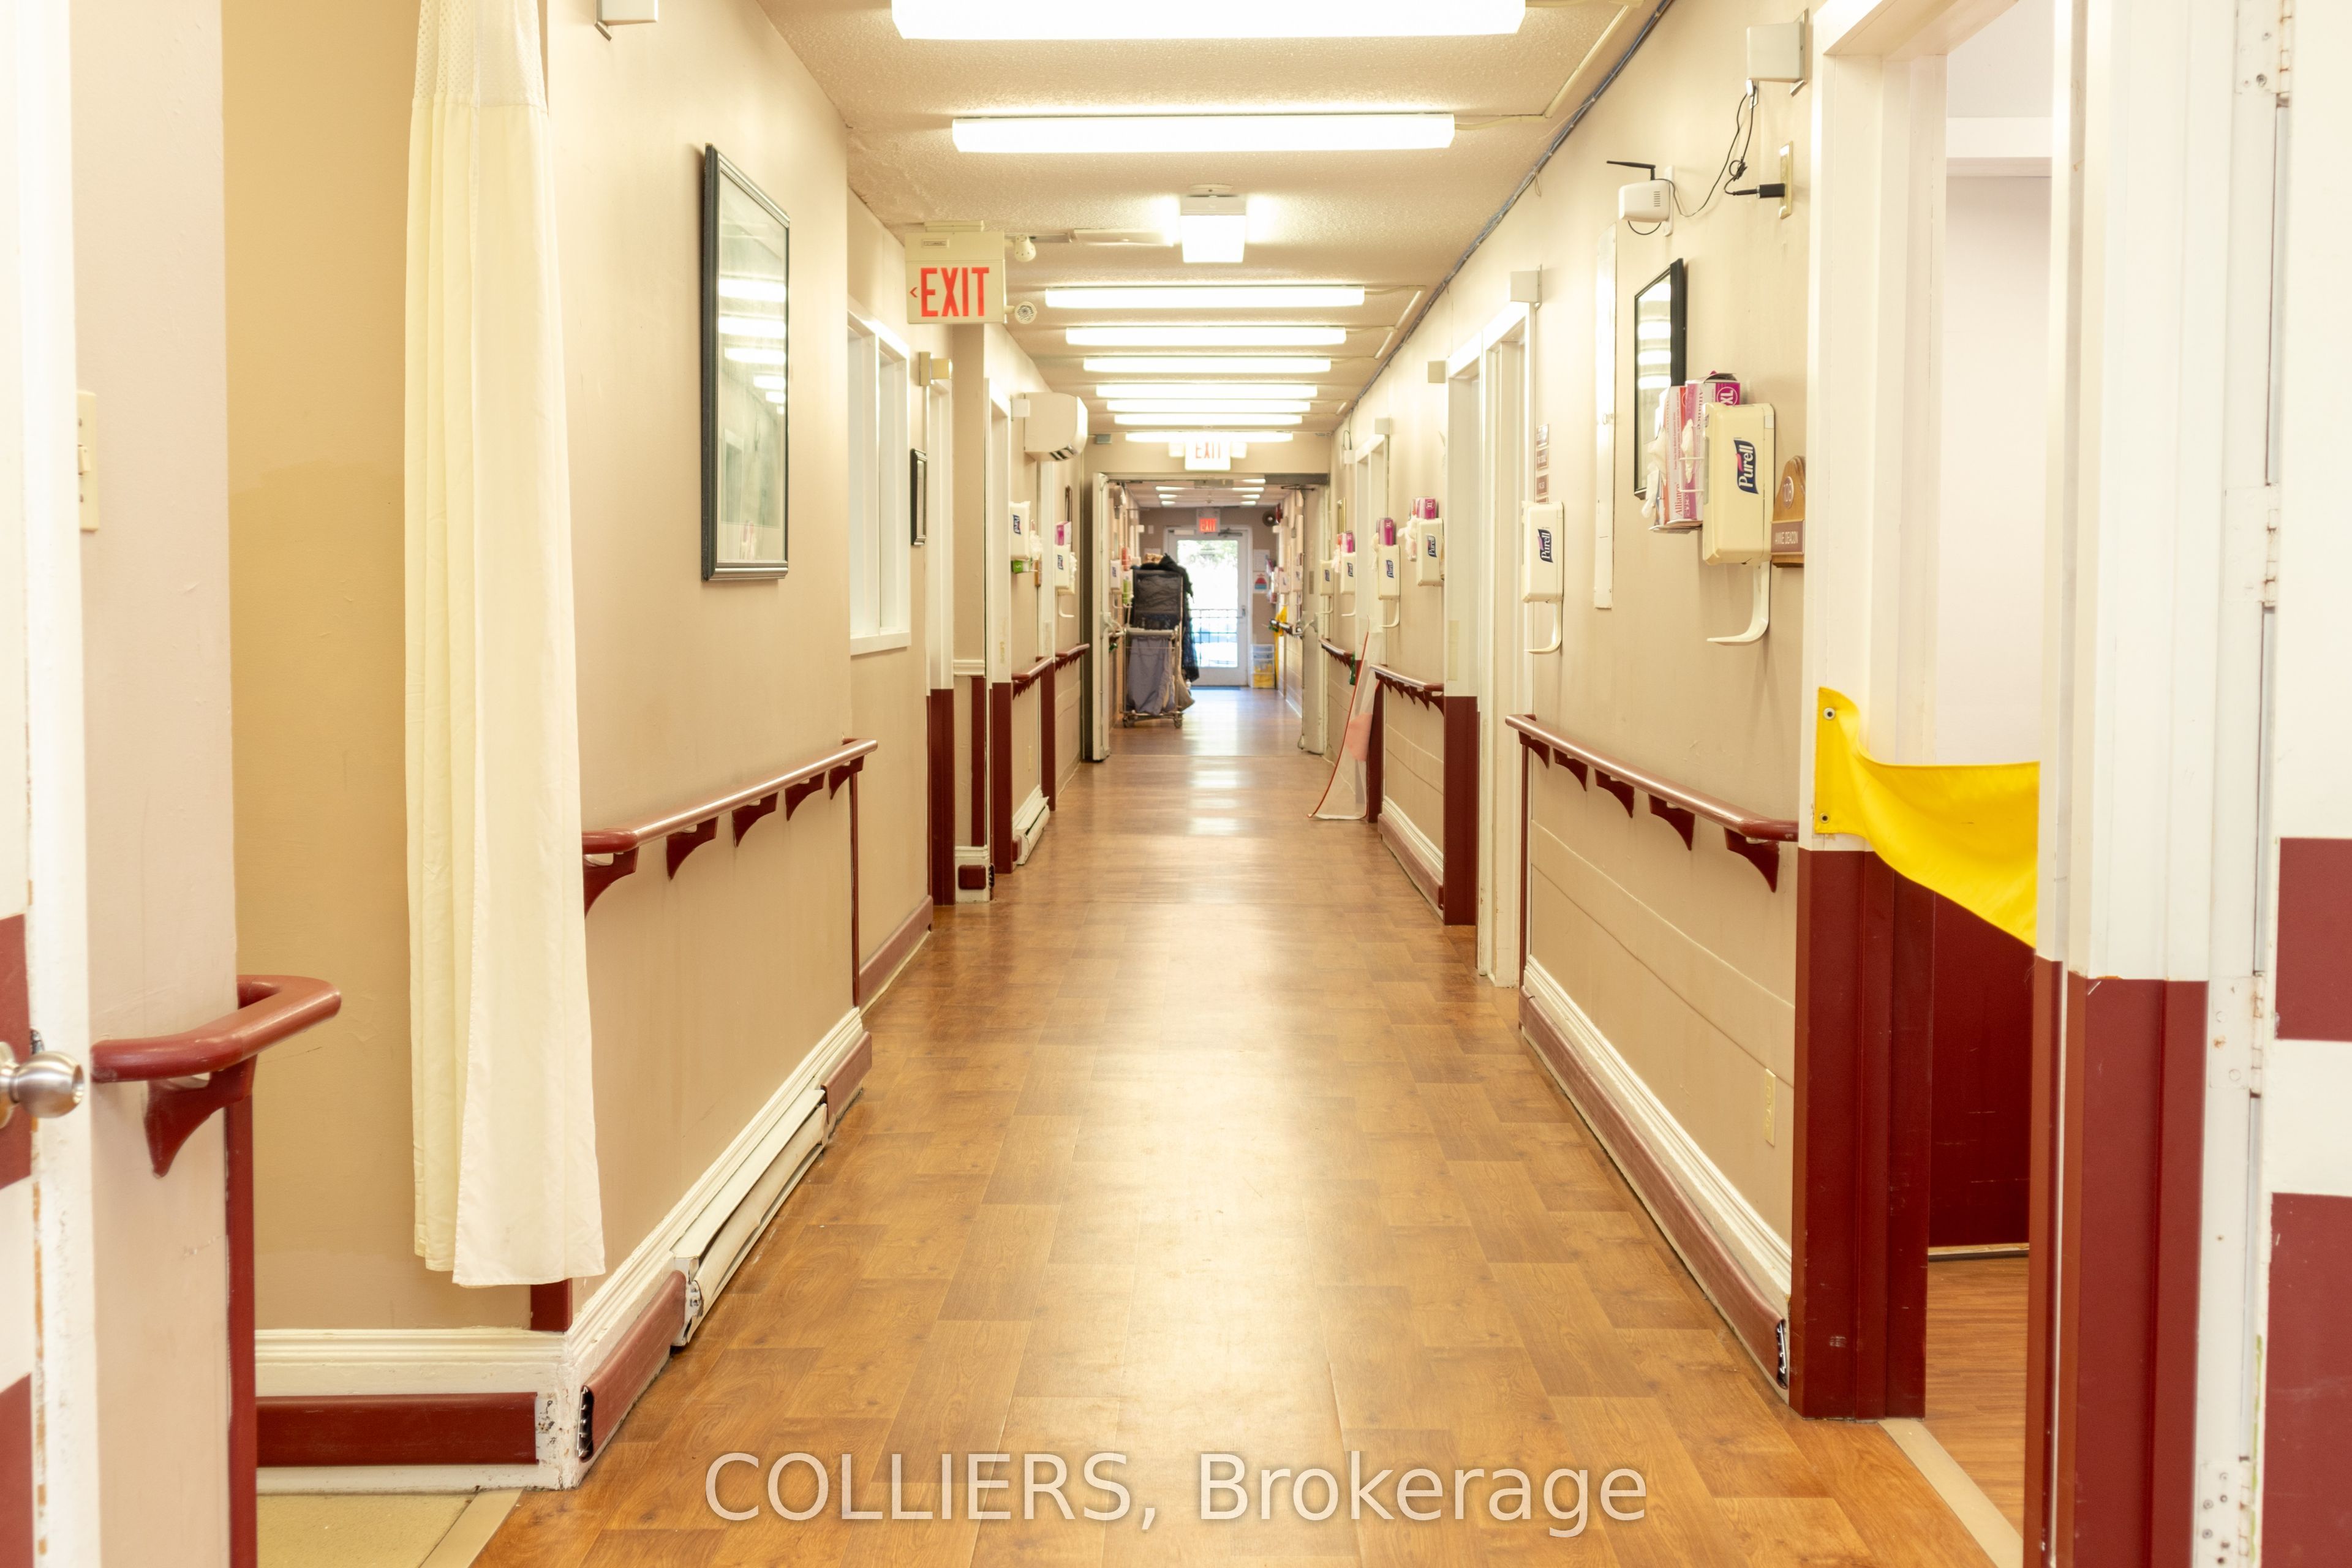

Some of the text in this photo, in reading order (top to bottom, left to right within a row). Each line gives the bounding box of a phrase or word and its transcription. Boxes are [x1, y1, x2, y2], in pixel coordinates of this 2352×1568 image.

[921, 266, 990, 317] EXIT
[1720, 390, 1733, 404] XL
[1738, 444, 1754, 488] Purell
[1200, 518, 1216, 532] EXIT
[1541, 532, 1550, 559] Purell
